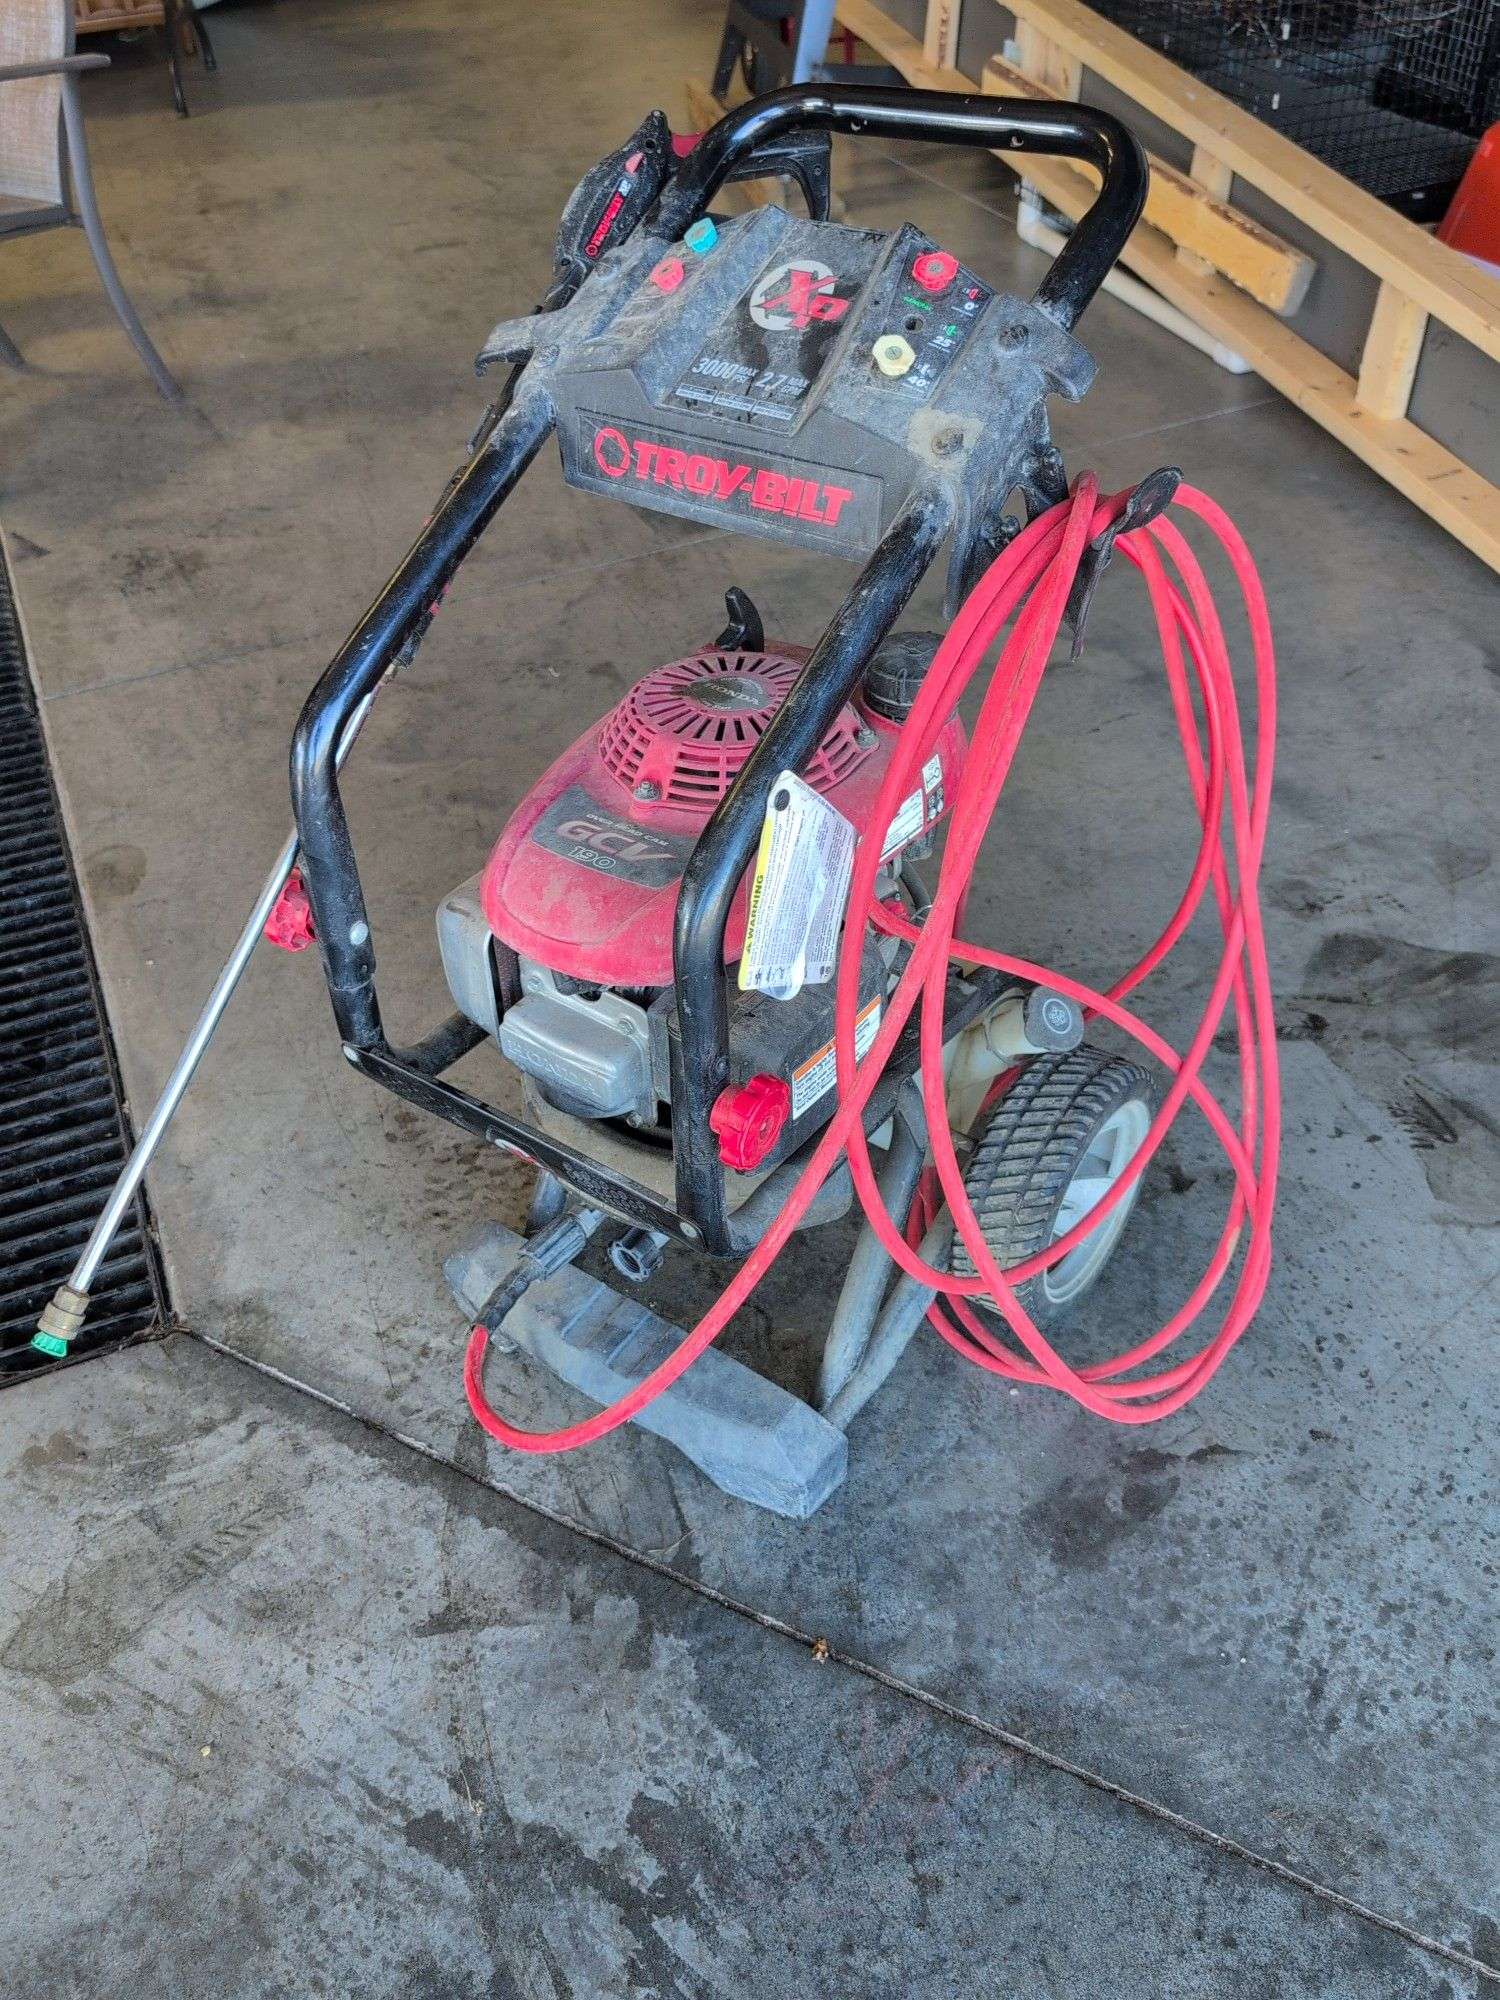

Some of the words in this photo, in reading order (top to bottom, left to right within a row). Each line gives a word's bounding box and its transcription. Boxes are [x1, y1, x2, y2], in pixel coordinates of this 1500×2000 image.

[691, 357, 740, 380] 3000
[632, 439, 854, 528] TROY-BILT
[556, 820, 677, 862] GCV
[568, 845, 616, 870] 190
[747, 874, 764, 940] WARNING
